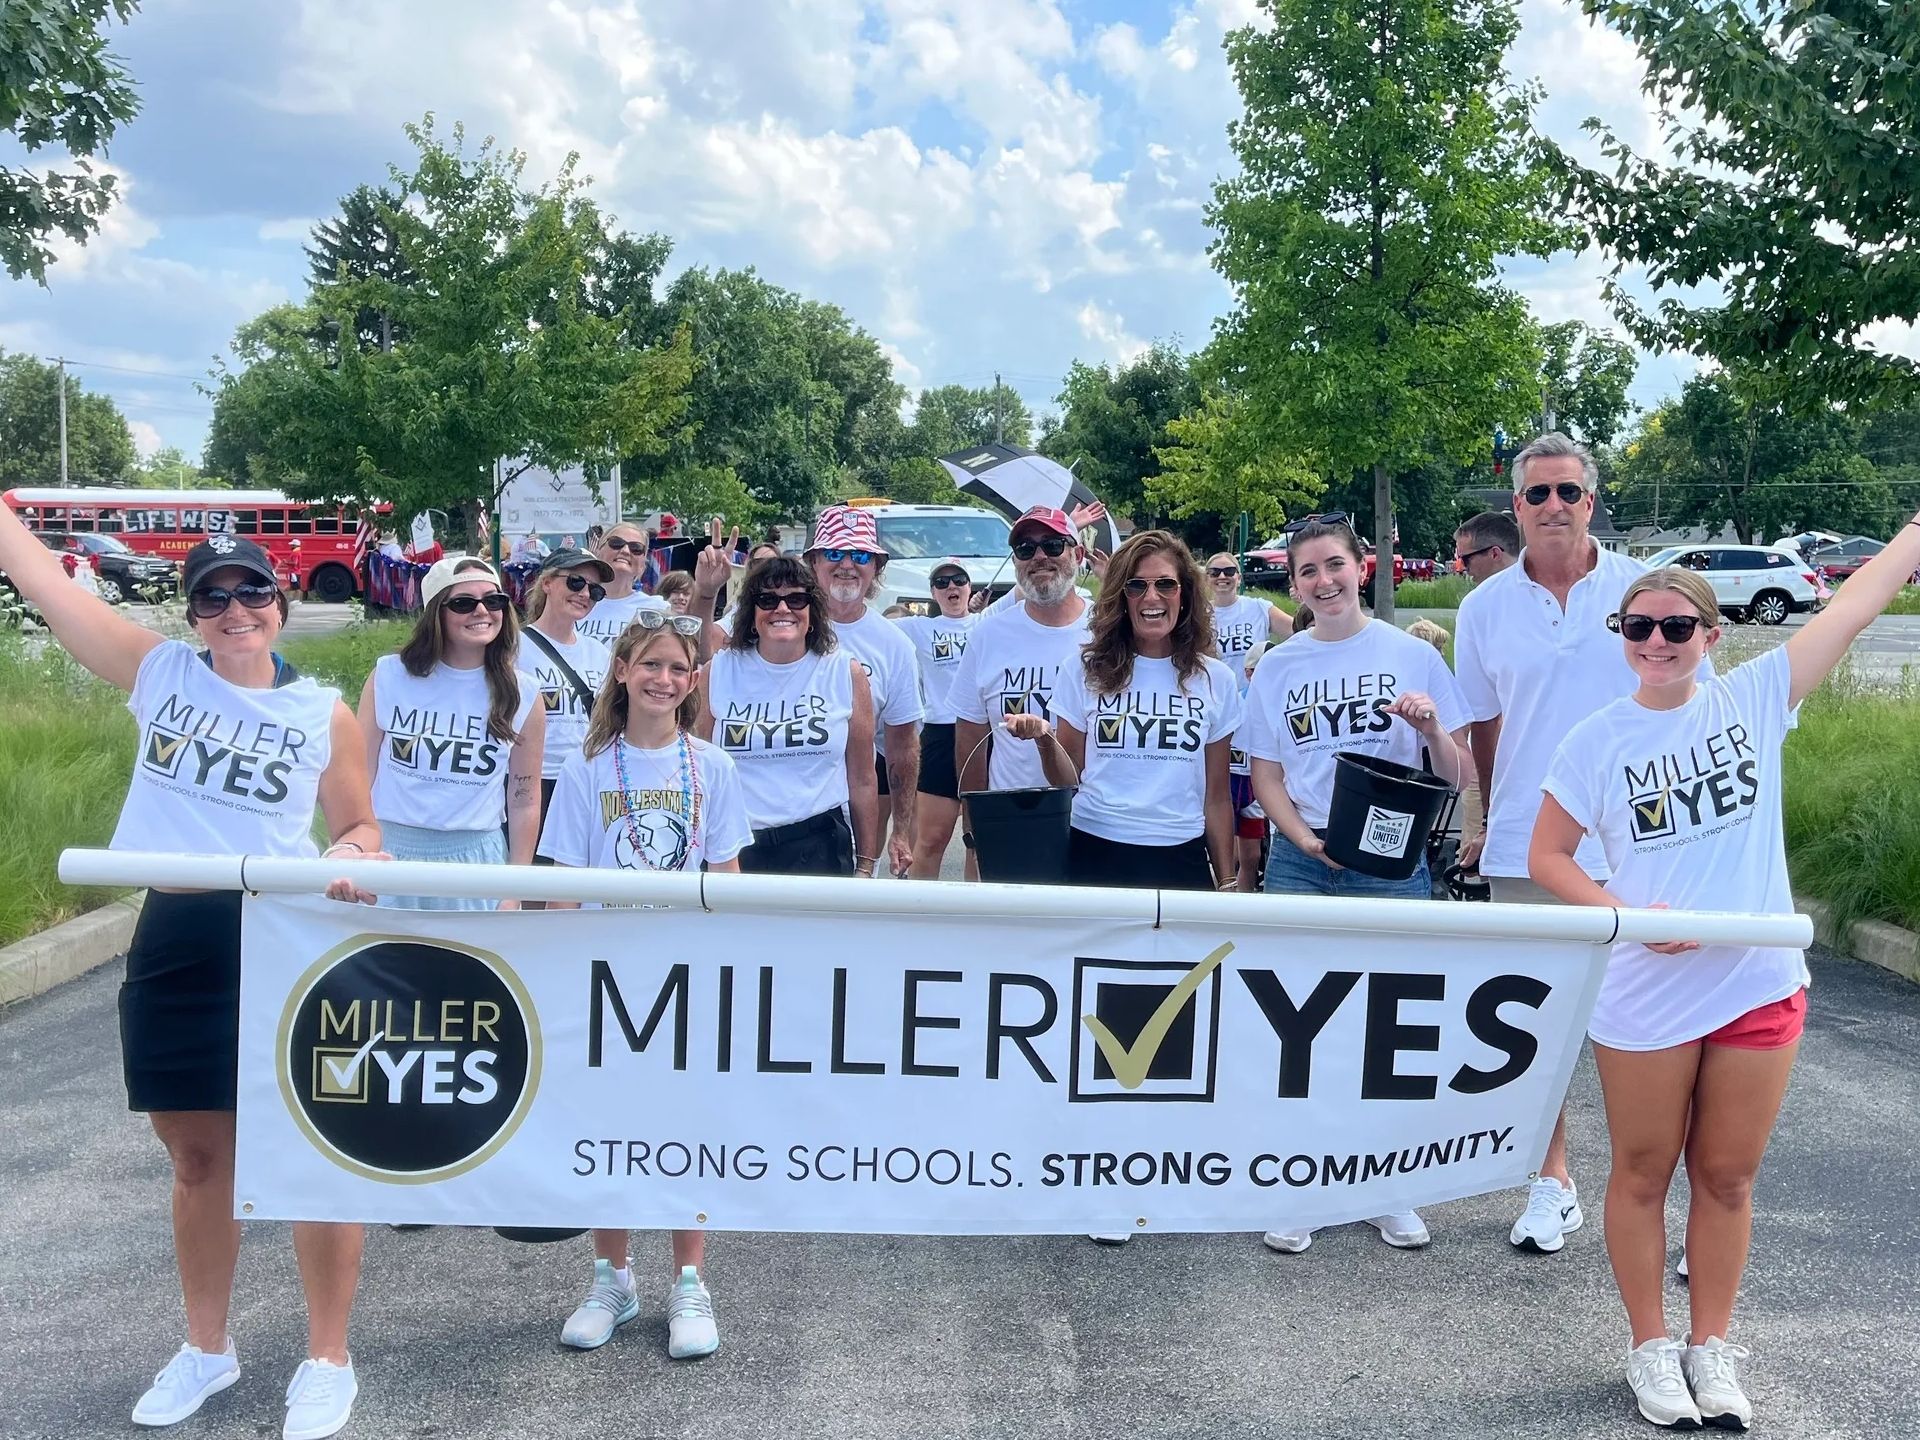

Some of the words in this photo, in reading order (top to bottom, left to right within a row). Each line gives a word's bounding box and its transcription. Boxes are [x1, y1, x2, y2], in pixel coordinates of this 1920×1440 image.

[123, 510, 239, 534] LIFEWISE
[1217, 635, 1254, 653] YES
[727, 695, 827, 723] MILLER
[1097, 691, 1205, 720] MILLER
[1287, 673, 1396, 710] MILLER
[155, 694, 306, 763] MILLER
[757, 716, 829, 749] YES
[1128, 715, 1201, 752] YES
[1318, 698, 1393, 737] YES
[193, 740, 293, 804] YES
[423, 737, 499, 776] YES
[1624, 724, 1755, 797] MILLER
[200, 794, 234, 808] STRONG
[1671, 760, 1758, 826] YES
[1373, 830, 1400, 844] UNITED
[1634, 844, 1662, 855] STRONG
[320, 999, 501, 1042] MILLER
[588, 960, 1058, 1083] MILLER
[1237, 968, 1552, 1100] YES
[371, 1050, 498, 1104] YES
[573, 1139, 768, 1180] STRONG
[786, 1144, 1023, 1188] SCHOOLS.
[1040, 1150, 1232, 1187] STRONG
[1248, 1126, 1514, 1187] COMMUNITY.
